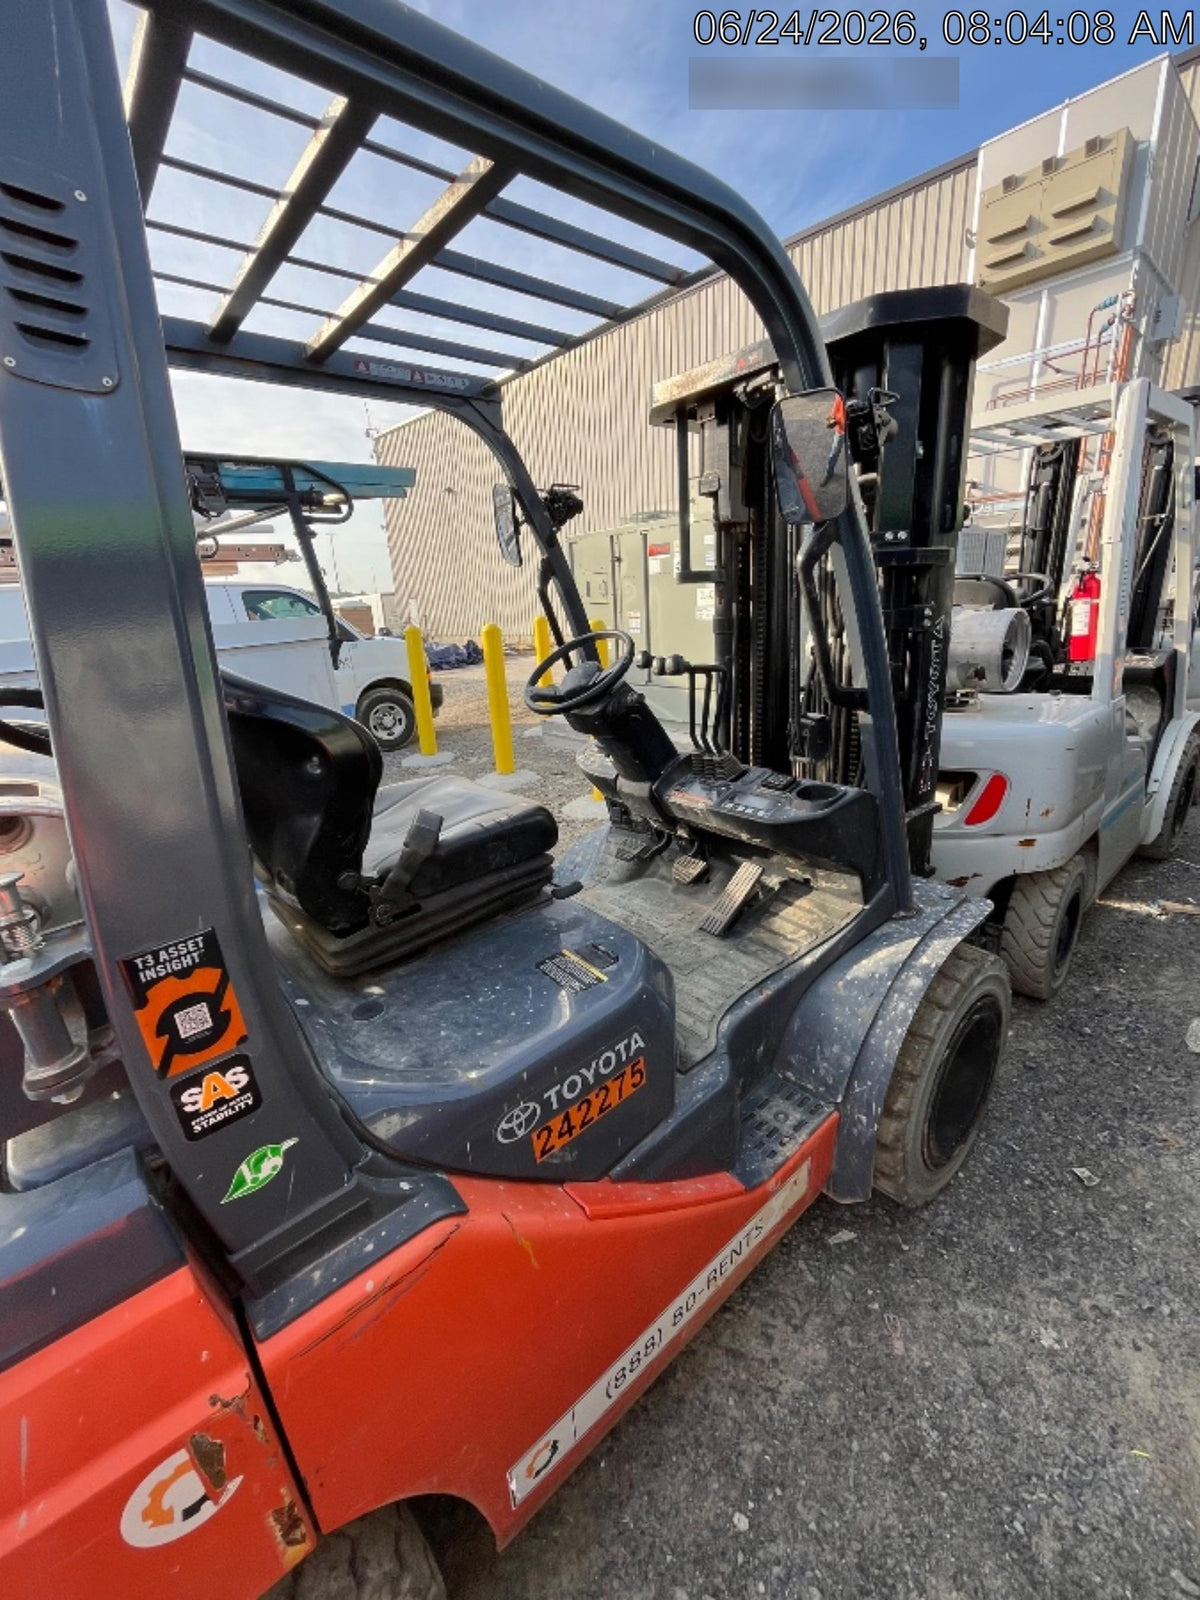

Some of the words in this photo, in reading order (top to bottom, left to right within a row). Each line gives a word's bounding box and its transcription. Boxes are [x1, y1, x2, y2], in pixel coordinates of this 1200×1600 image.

[134, 954, 155, 970] T3
[159, 936, 204, 963] ASSET
[138, 952, 200, 983] INSIGHT
[180, 1065, 250, 1113] SAS
[543, 1032, 646, 1111] TOYOTA
[192, 1097, 254, 1134] STABILITY
[536, 1060, 645, 1160] 242275
[605, 1328, 663, 1399] (888)
